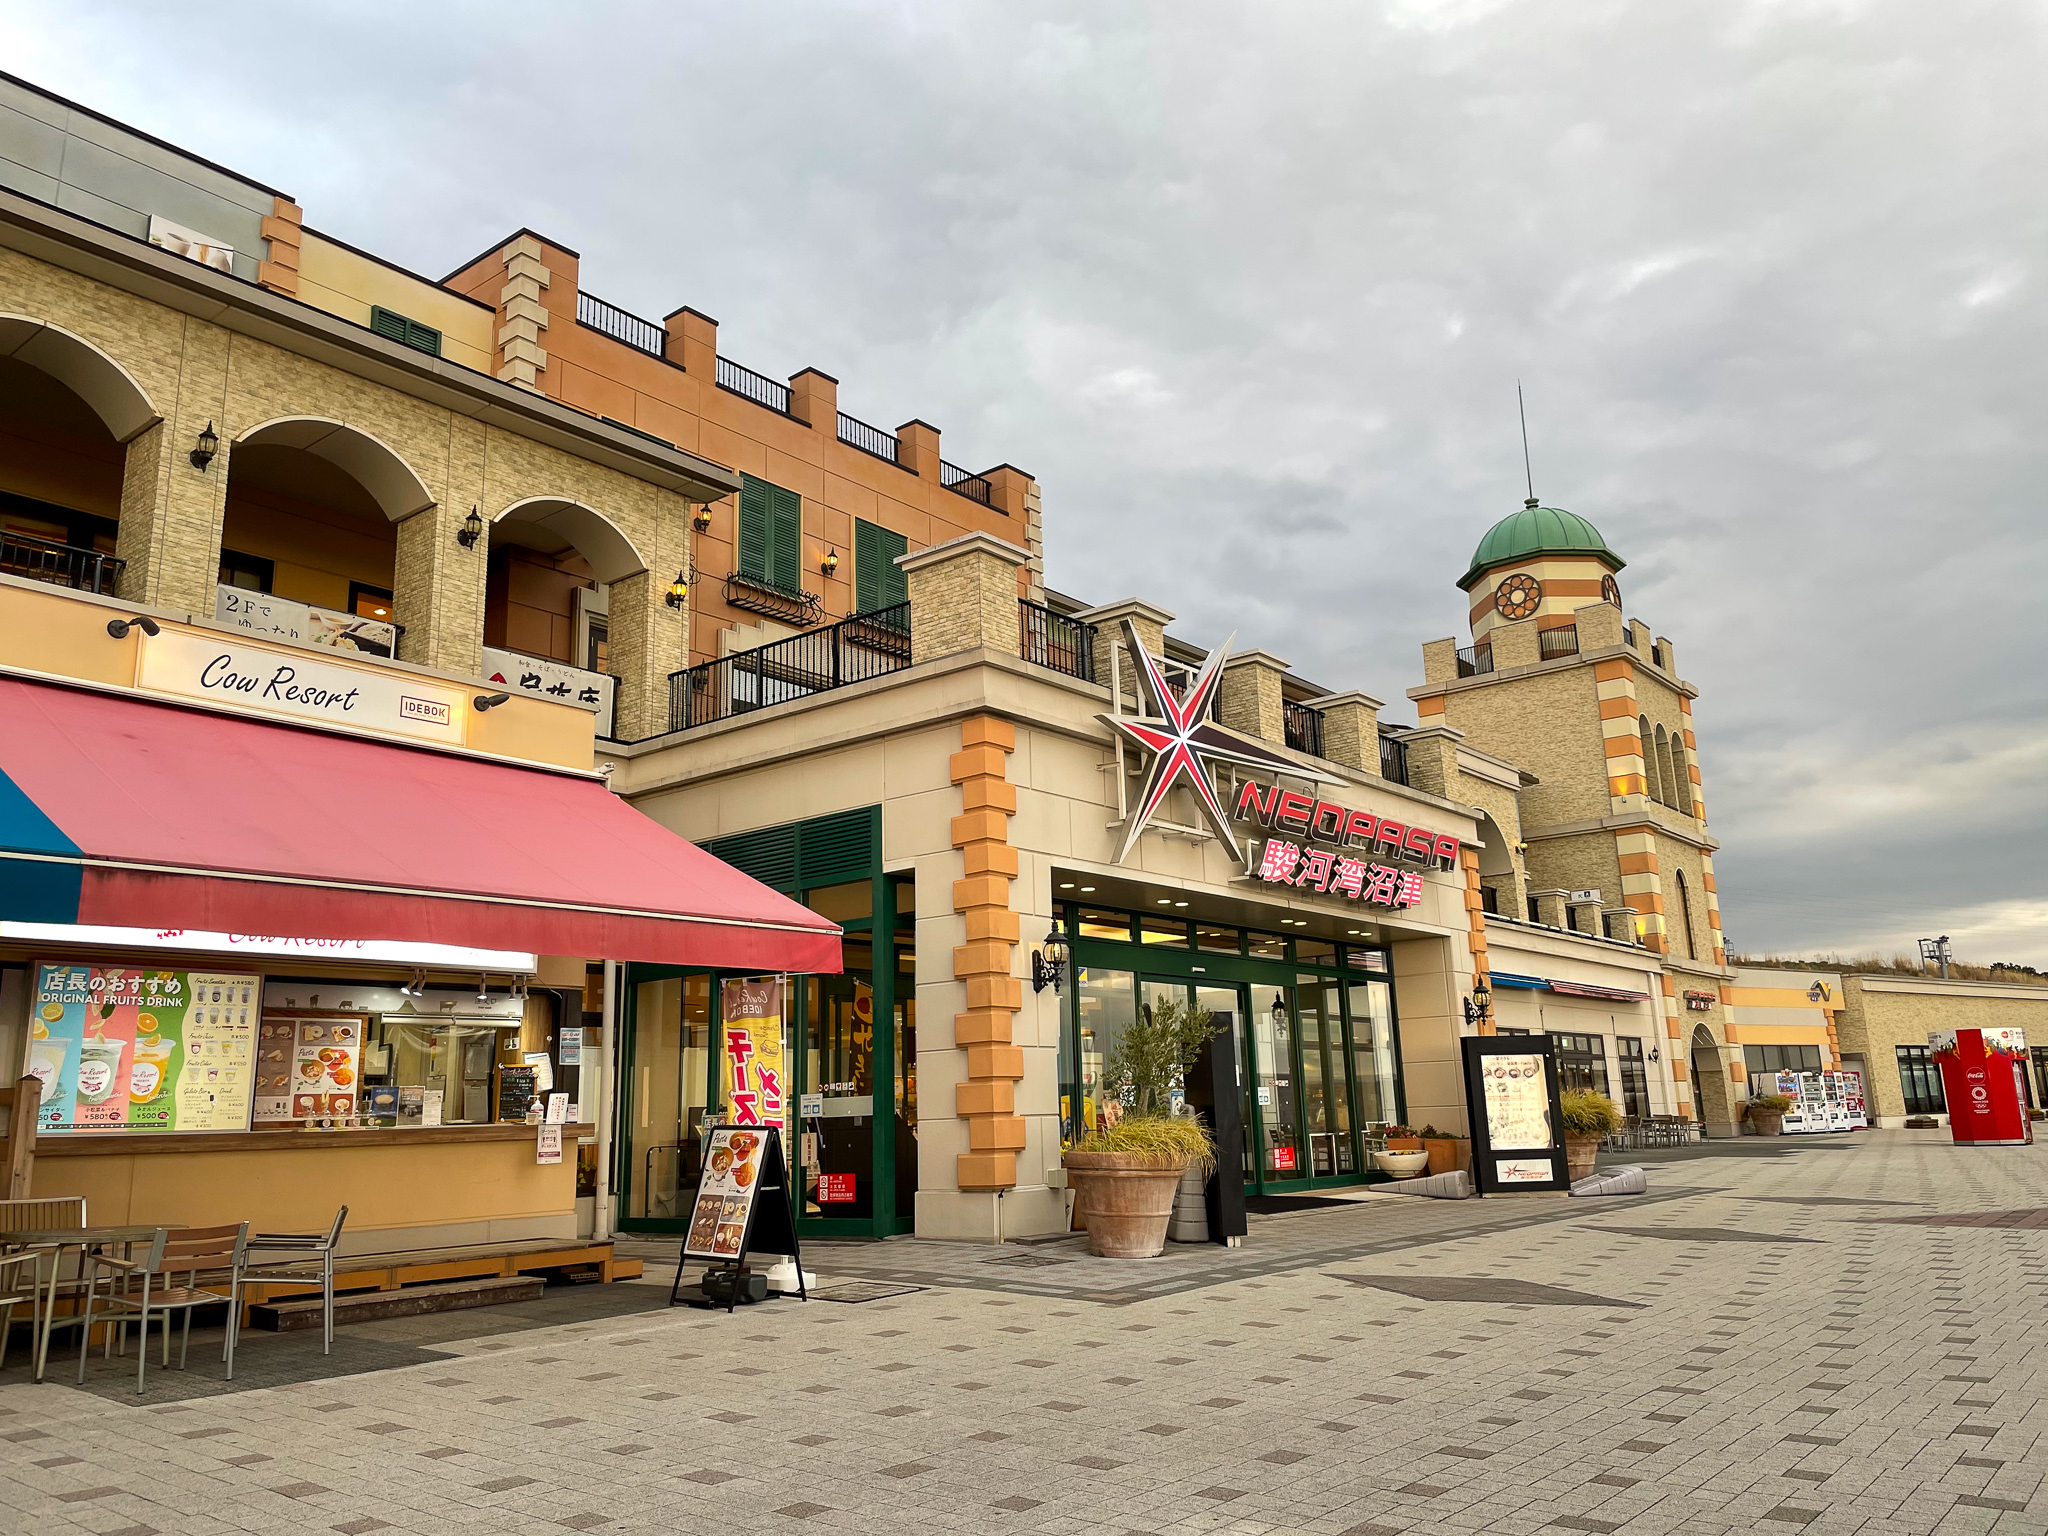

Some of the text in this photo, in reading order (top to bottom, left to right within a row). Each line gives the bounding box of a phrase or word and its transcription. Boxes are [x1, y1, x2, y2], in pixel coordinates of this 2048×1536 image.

[200, 654, 359, 711] Cow Resort
[405, 701, 446, 717] IDEBOK
[1234, 780, 1460, 872] NEOPASA
[1258, 838, 1424, 909] 駿河湾沼津
[44, 971, 182, 995] 店長のおすすめ
[41, 992, 183, 1007] ORIGINAL FRUITS DRINK
[298, 1048, 315, 1057] Pasta
